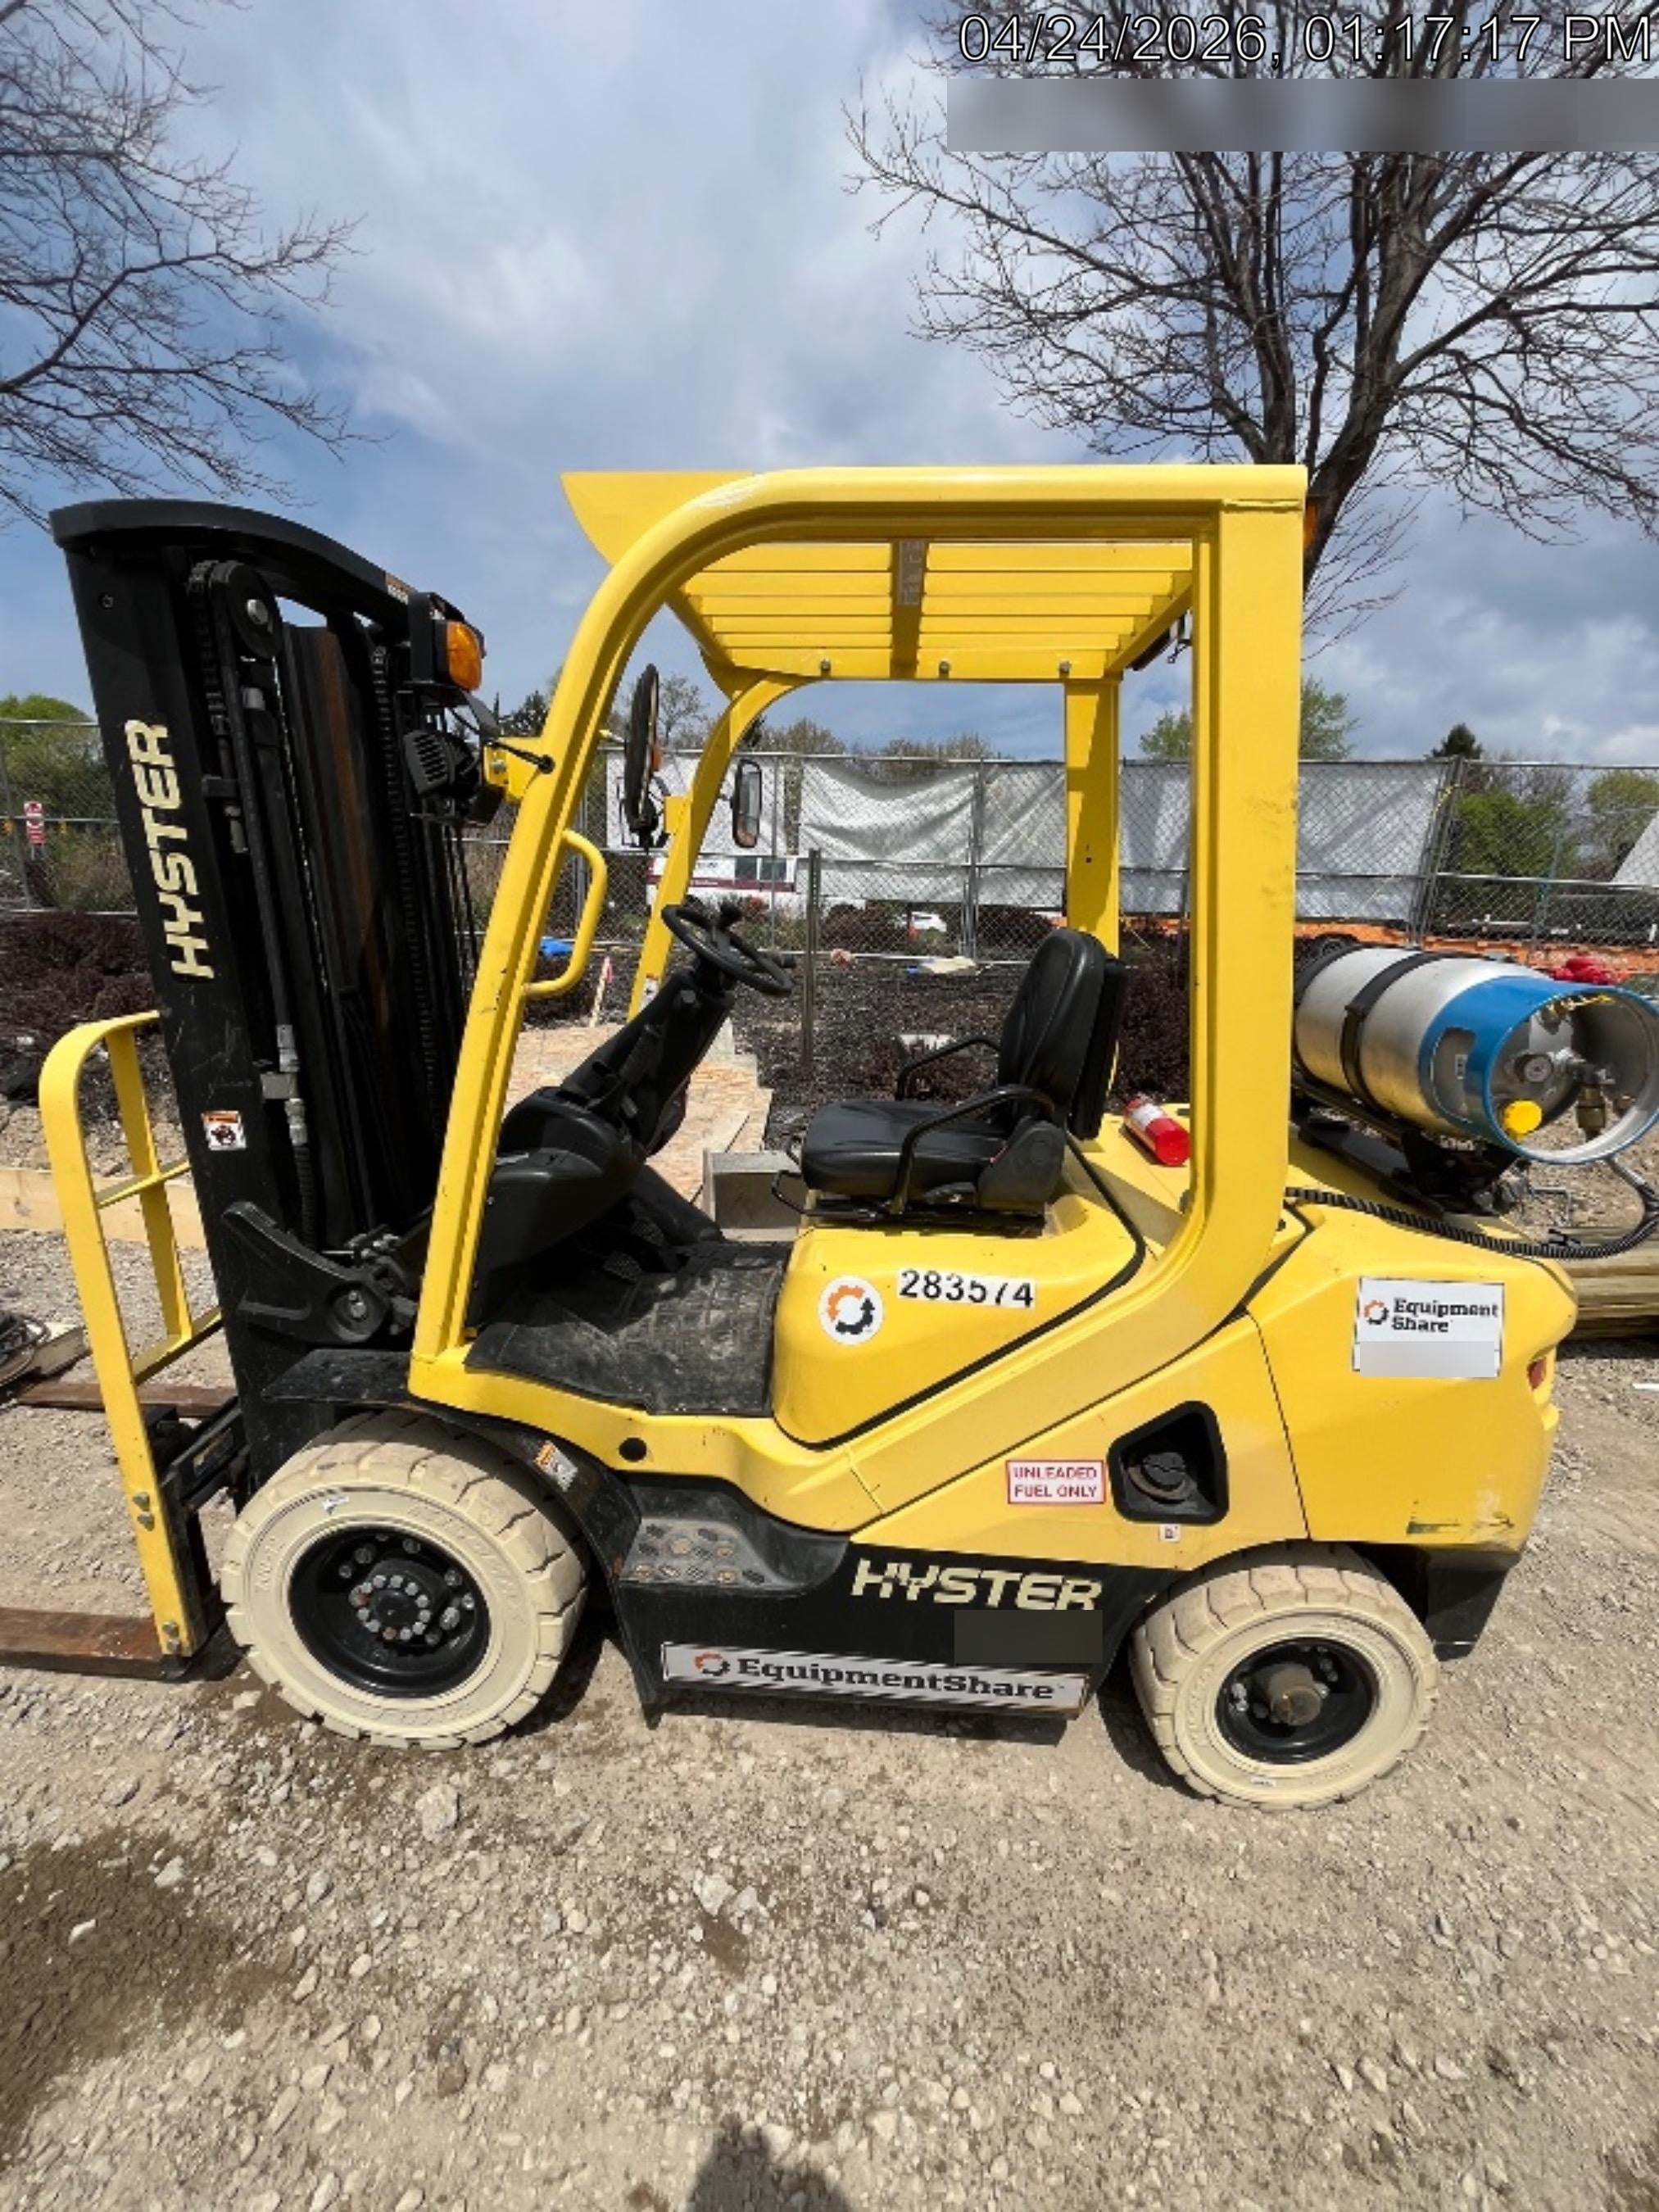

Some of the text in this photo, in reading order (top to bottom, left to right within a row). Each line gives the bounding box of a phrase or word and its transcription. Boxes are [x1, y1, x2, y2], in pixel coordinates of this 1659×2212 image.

[125, 719, 214, 979] HYSTER
[899, 1269, 1034, 1308] 283574
[1393, 1298, 1498, 1317] Equipment
[1391, 1317, 1449, 1333] Share
[1013, 1466, 1097, 1479] UNLEADED
[1014, 1484, 1097, 1498] FUEL ONLY
[850, 1557, 1103, 1611] HYSTER
[737, 1657, 1055, 1700] EquipmentShare
